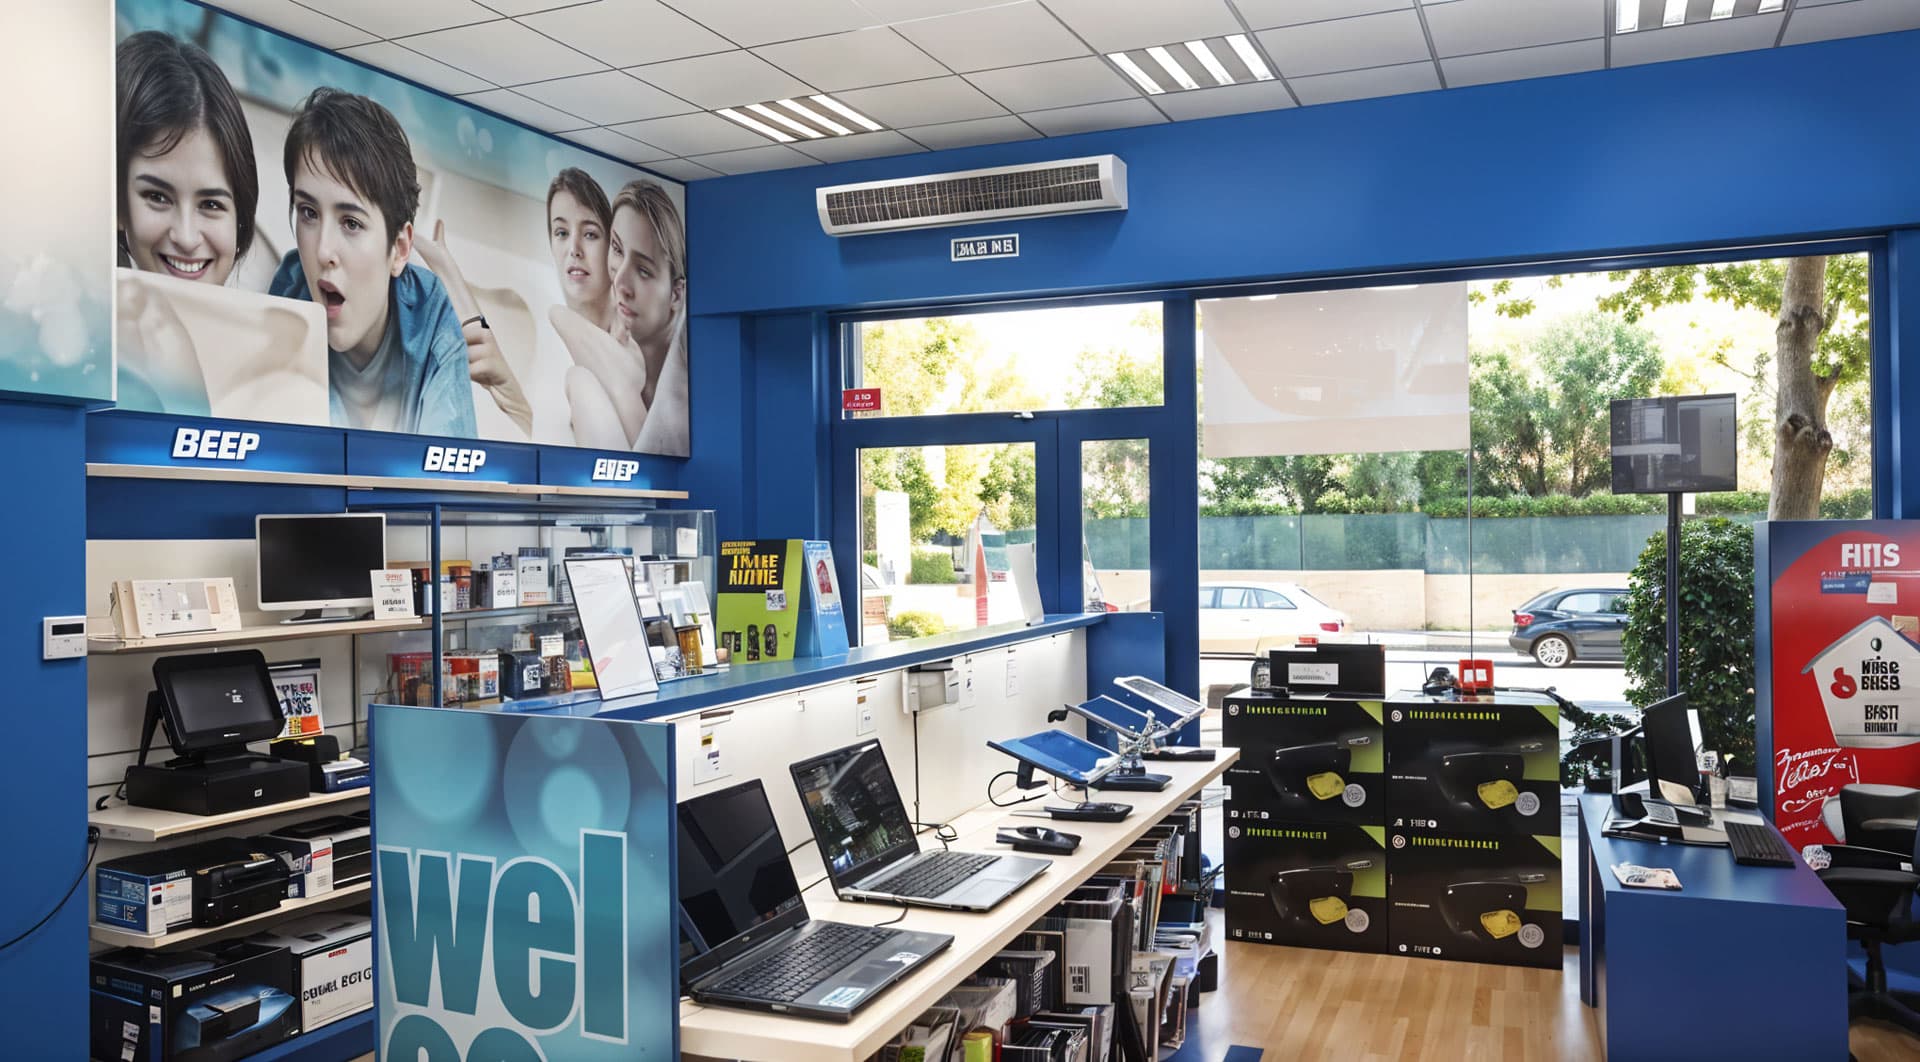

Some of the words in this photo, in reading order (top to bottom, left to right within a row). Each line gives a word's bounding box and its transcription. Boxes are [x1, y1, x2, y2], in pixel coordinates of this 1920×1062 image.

[172, 427, 261, 461] BEEP
[423, 445, 487, 473] BEEP
[375, 827, 629, 1045] wel
